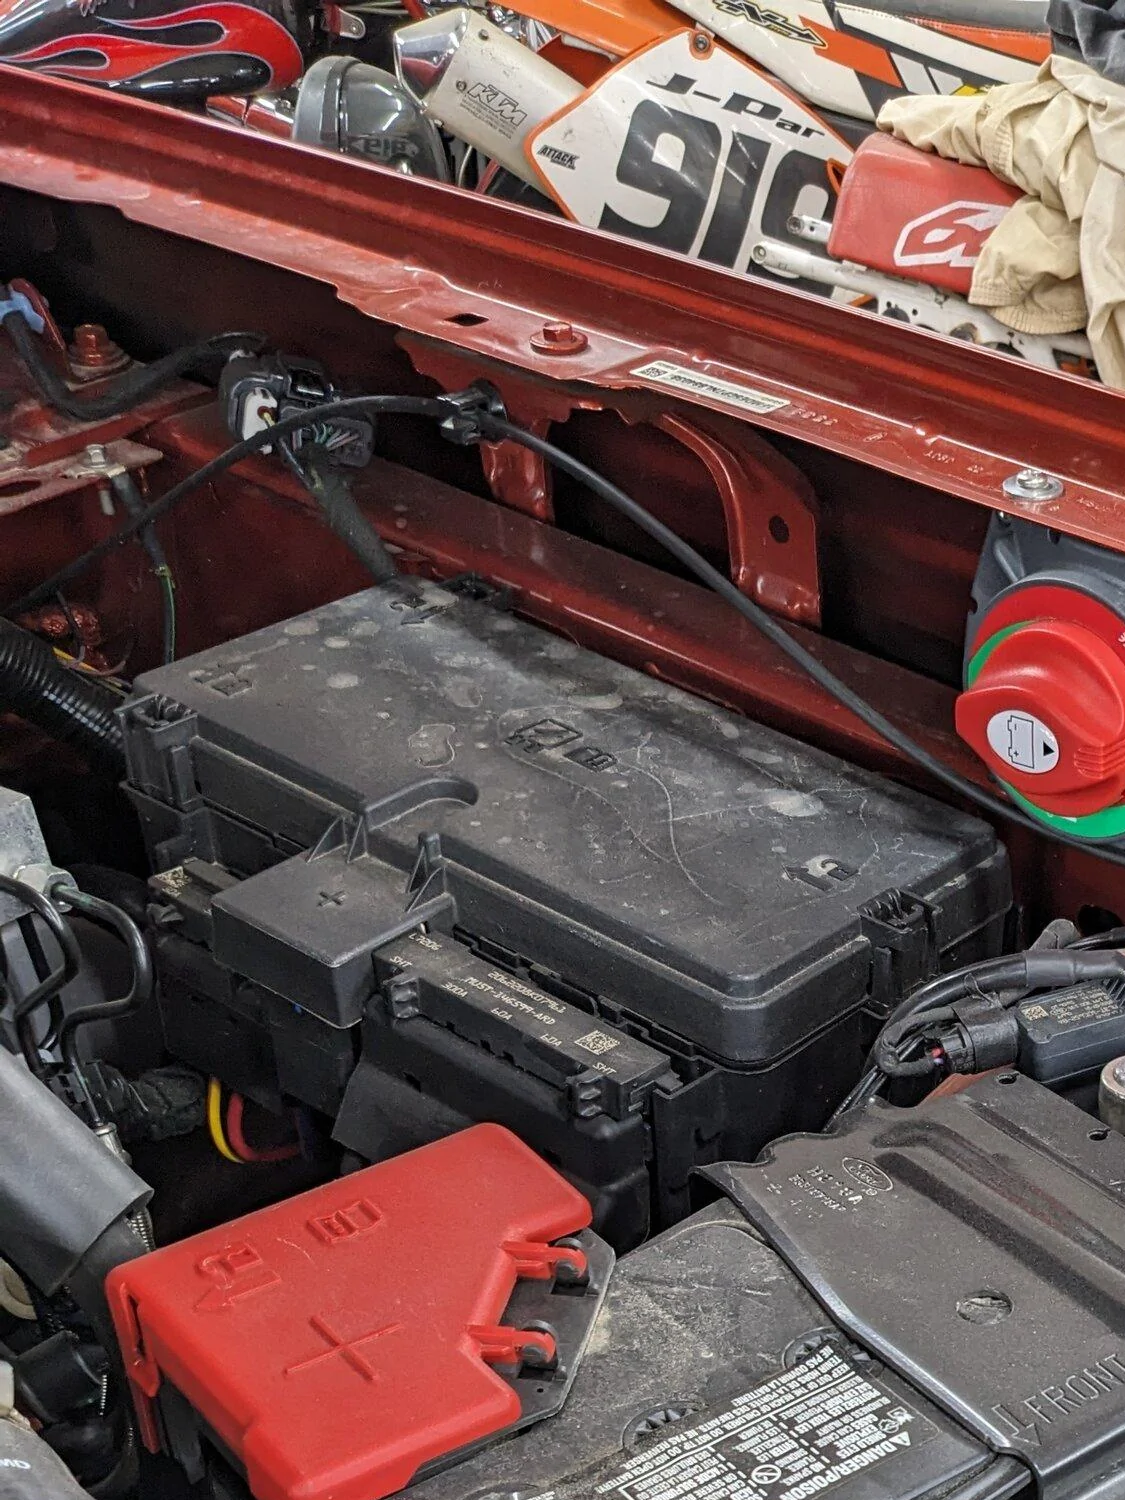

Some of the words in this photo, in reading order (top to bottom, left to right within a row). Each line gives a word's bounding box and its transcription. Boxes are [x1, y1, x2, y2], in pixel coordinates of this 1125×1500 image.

[467, 82, 527, 126] KTM
[537, 145, 580, 165] ATTACK
[491, 1007, 512, 1020] 60A
[540, 1034, 562, 1047] 60A
[817, 1345, 834, 1358] NE
[804, 1353, 824, 1368] PAS
[816, 1354, 843, 1373] TENIR
[777, 1363, 809, 1383] OUVRIR
[795, 1368, 821, 1384] HORS
[828, 1362, 851, 1378] KEEP
[766, 1379, 781, 1389] LA
[785, 1379, 800, 1389] DE
[803, 1380, 819, 1391] OF
[813, 1373, 833, 1385] OUT
[774, 1385, 789, 1395] LA
[790, 1385, 809, 1397] THE
[854, 1381, 873, 1393] GAZ
[767, 1392, 795, 1408] REACH
[731, 1404, 751, 1417] DES
[757, 1403, 772, 1413] OF
[827, 1405, 846, 1417] LES
[759, 1419, 773, 1429] DE
[807, 1411, 832, 1427] YEUX
[838, 1413, 854, 1424] OR
[849, 1412, 879, 1430] GASES
[683, 1428, 698, 1438] NE
[708, 1427, 724, 1437] DO
[764, 1425, 781, 1437] LES
[793, 1421, 812, 1434] LES
[835, 1424, 855, 1437] CAN
[666, 1433, 687, 1445] PAS
[692, 1433, 712, 1445] NOT
[812, 1431, 841, 1448] CAUSE
[832, 1423, 878, 1449] EXPLOSIVE
[855, 1430, 887, 1448] SHIELD
[666, 1445, 682, 1457] DO
[693, 1449, 711, 1461] DES
[755, 1452, 772, 1463] LES
[834, 1443, 860, 1459] EYES
[649, 1452, 670, 1466] NOT
[698, 1456, 720, 1469] PEUT
[629, 1460, 655, 1476] OPEN
[808, 1461, 826, 1472] NO
[693, 1463, 729, 1484] L'ACIDE
[721, 1472, 738, 1483] OR
[632, 1473, 664, 1492] GRAVES
[666, 1476, 680, 1486] LA
[725, 1478, 746, 1492] CAN
[693, 1478, 726, 1498] SEVERE
[635, 1491, 650, 1500] OU
